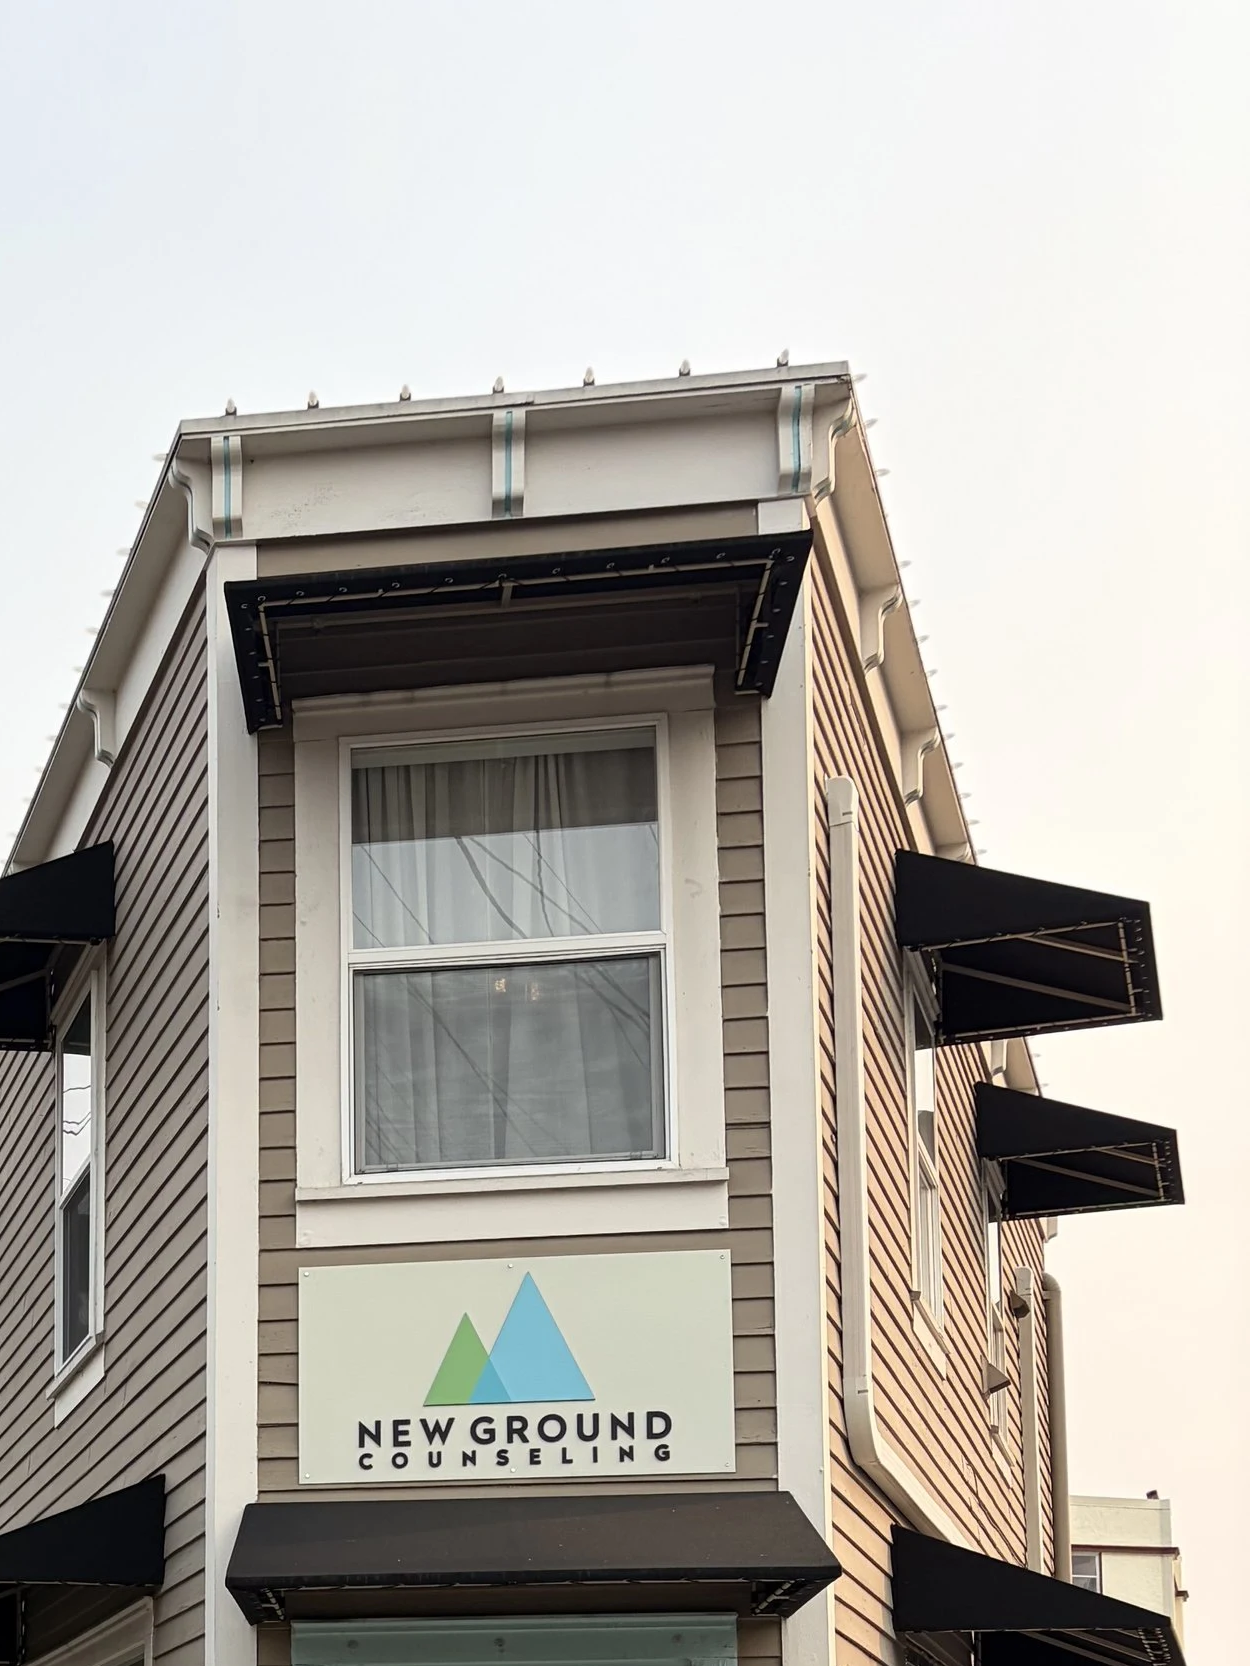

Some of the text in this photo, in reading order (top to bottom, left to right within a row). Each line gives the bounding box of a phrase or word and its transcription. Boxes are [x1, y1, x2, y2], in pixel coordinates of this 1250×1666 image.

[358, 1410, 673, 1448] NEW GROUND
[358, 1443, 671, 1470] COUNSELING
